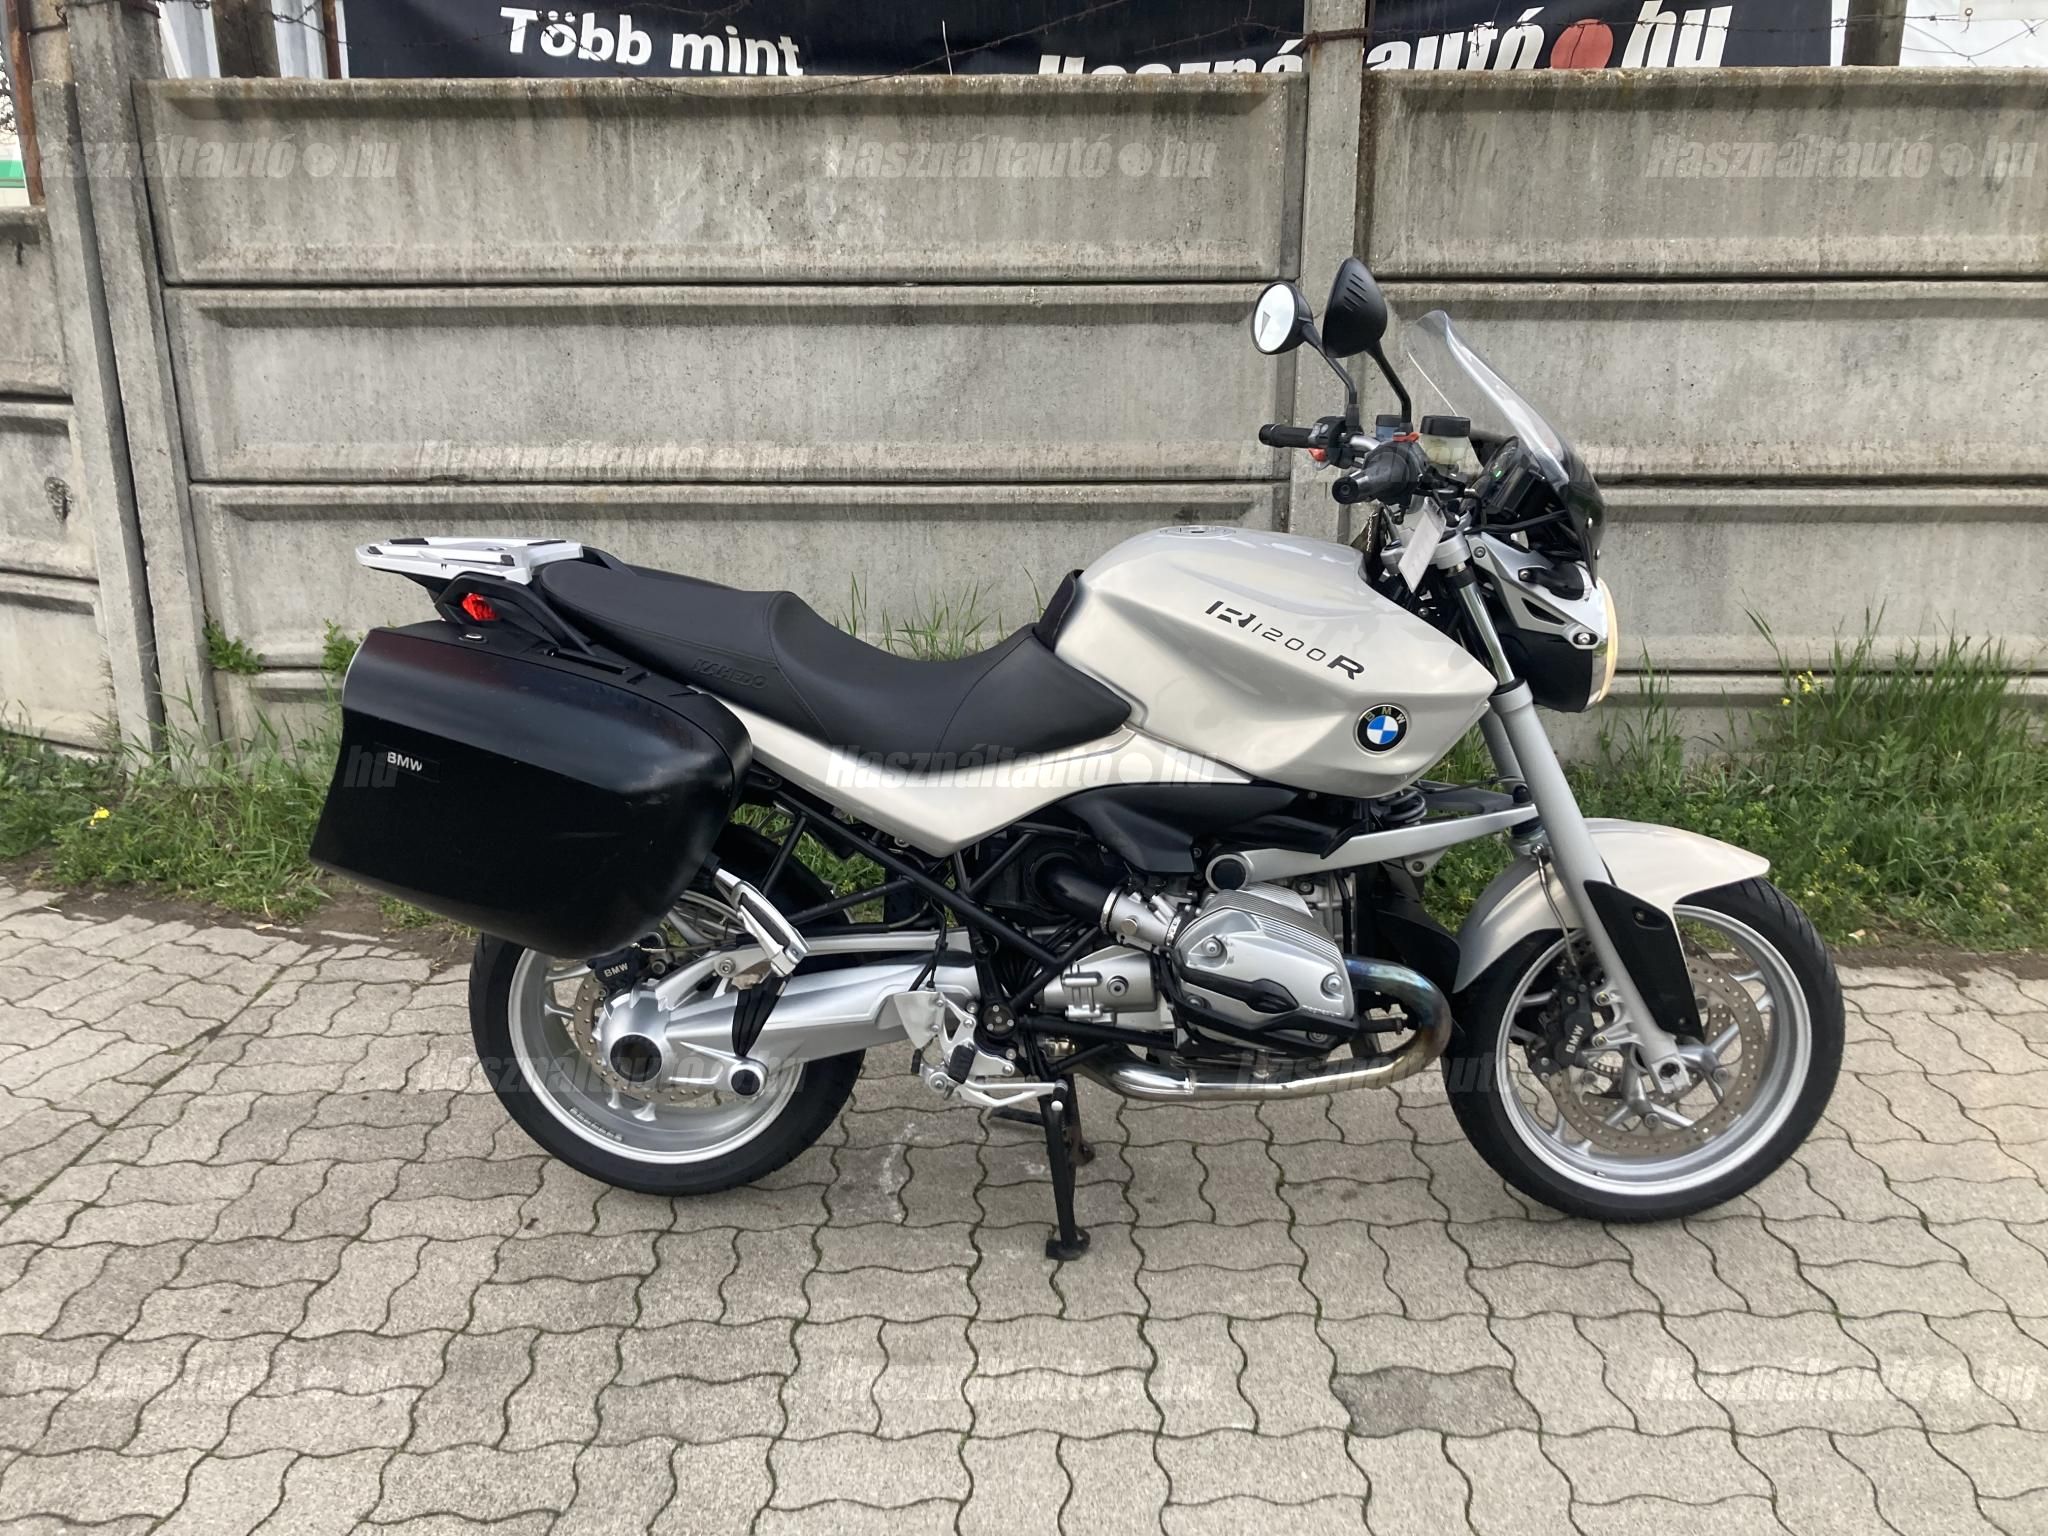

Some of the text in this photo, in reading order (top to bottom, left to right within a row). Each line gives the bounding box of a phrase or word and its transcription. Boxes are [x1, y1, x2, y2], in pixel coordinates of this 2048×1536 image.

[500, 6, 804, 76] Több mint
[386, 751, 423, 772] BMW
[604, 962, 628, 977] BMW
[1565, 1024, 1585, 1054] BMW
